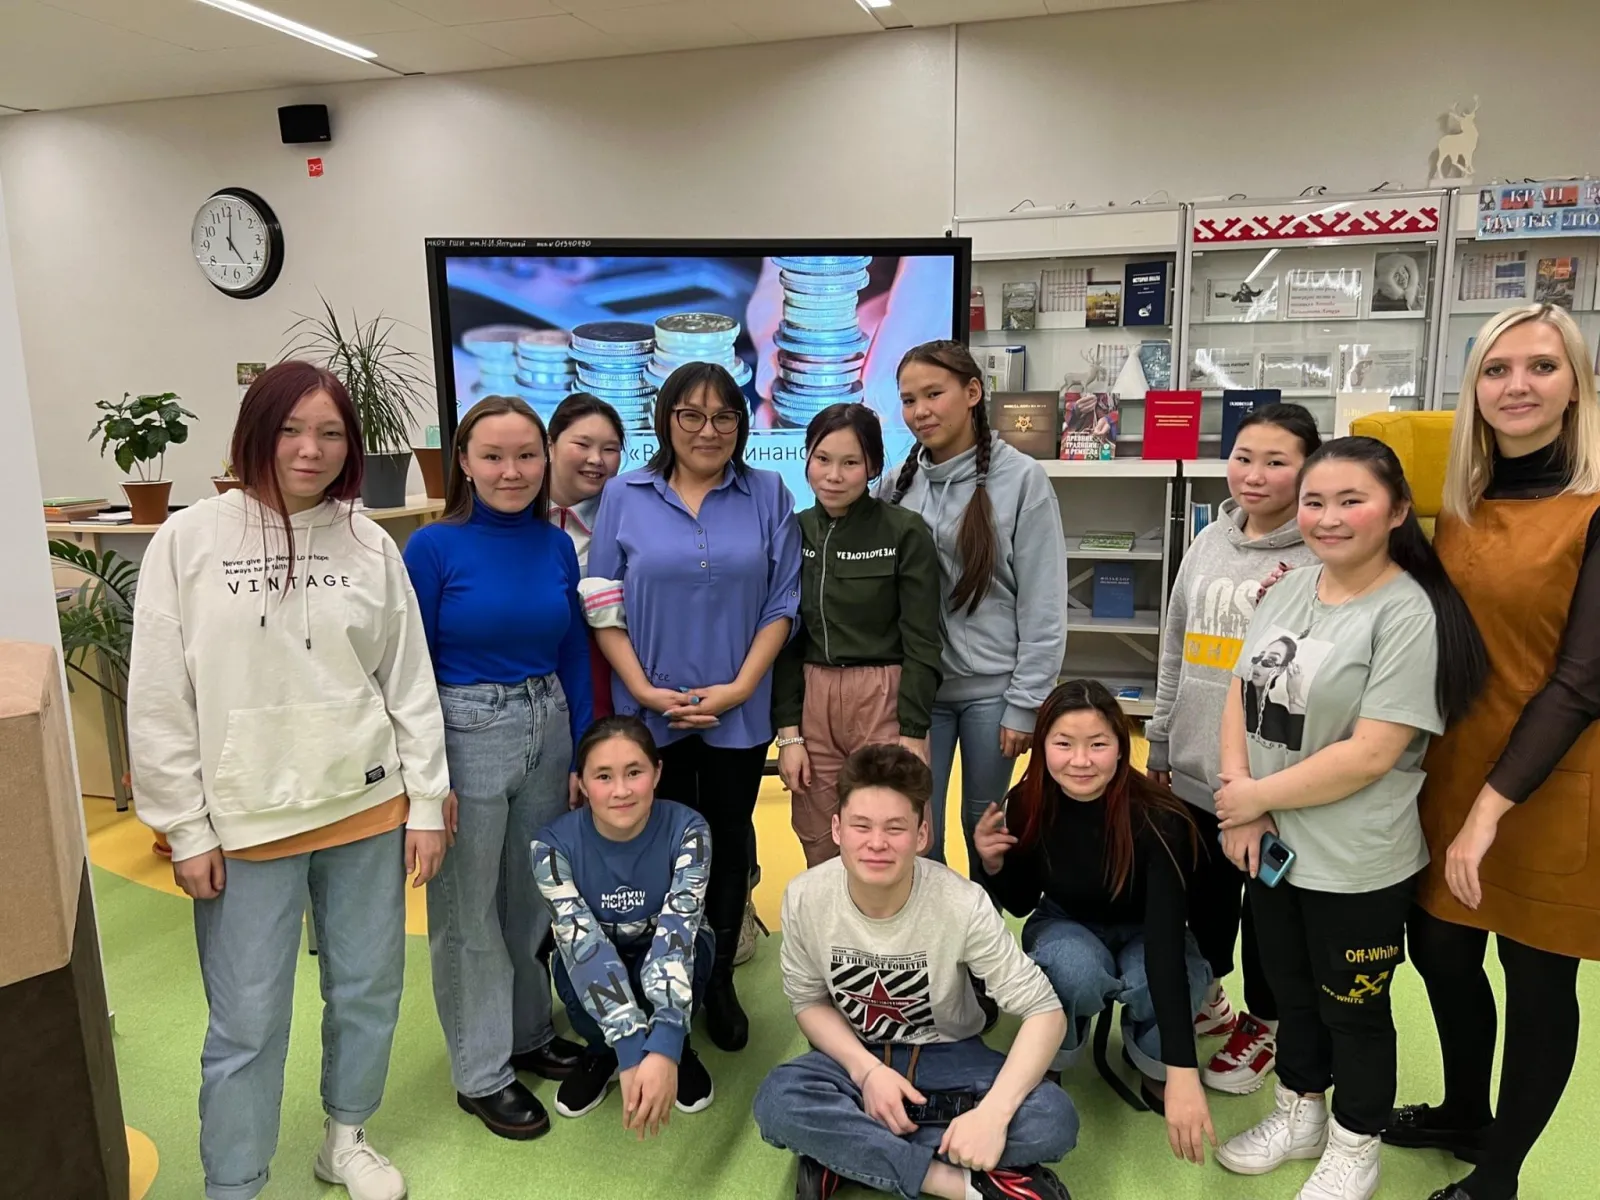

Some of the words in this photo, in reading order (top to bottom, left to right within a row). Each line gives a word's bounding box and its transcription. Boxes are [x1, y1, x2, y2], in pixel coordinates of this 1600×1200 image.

[221, 206, 232, 218] 12
[211, 213, 221, 224] 11
[247, 218, 254, 229] 2
[205, 226, 215, 237] 10
[255, 234, 262, 245] 3
[203, 240, 210, 252] 9
[253, 250, 260, 261] 4
[210, 256, 217, 267] 8
[221, 265, 228, 276] 7
[233, 268, 241, 279] 6
[223, 559, 244, 567] Never
[246, 558, 261, 566] give
[227, 574, 351, 595] VINTAGE
[1345, 944, 1399, 963] Off-White
